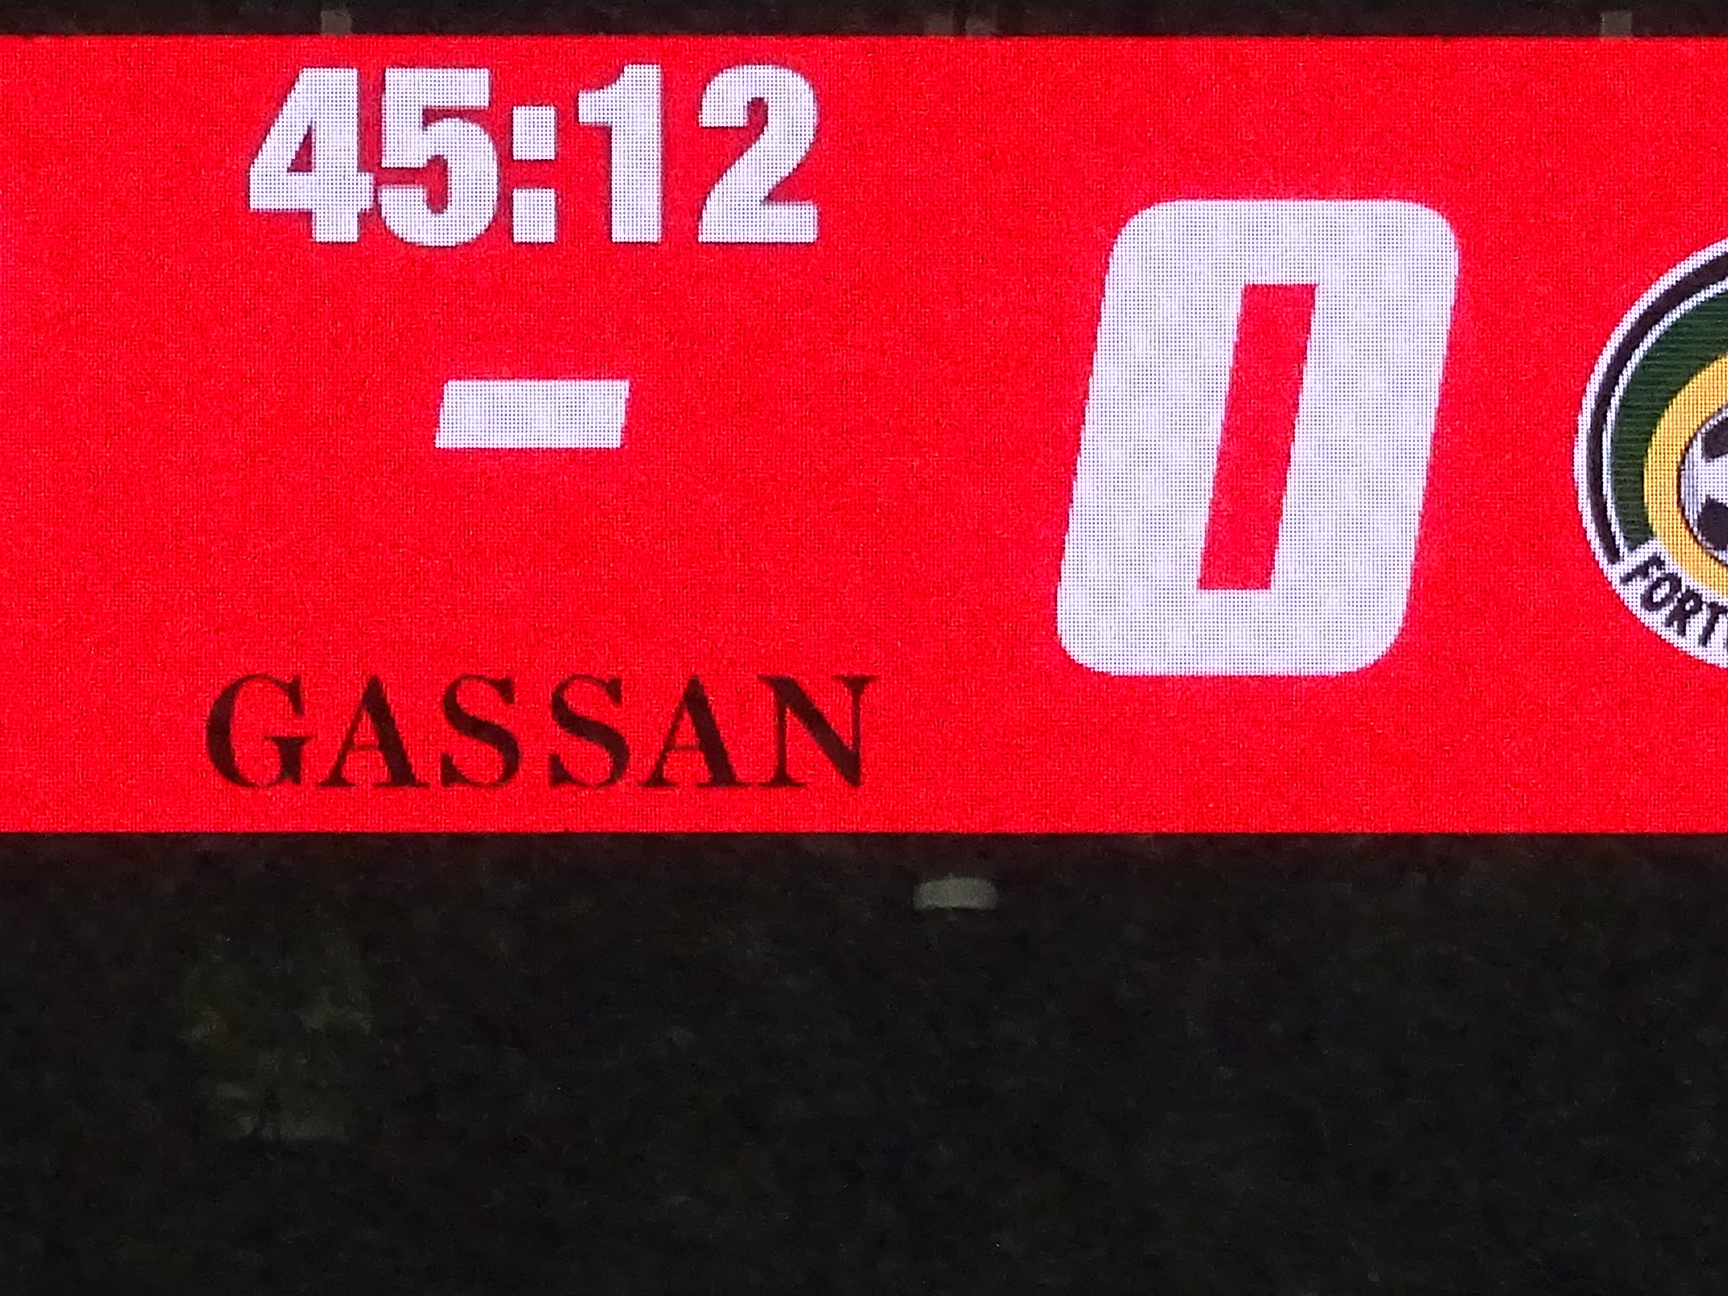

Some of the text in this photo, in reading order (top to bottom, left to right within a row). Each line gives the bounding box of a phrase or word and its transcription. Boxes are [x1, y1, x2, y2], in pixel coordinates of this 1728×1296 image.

[246, 64, 820, 247] 45:12
[435, 379, 630, 449] -
[1056, 199, 1460, 676] 0
[205, 673, 880, 787] GASSAN
